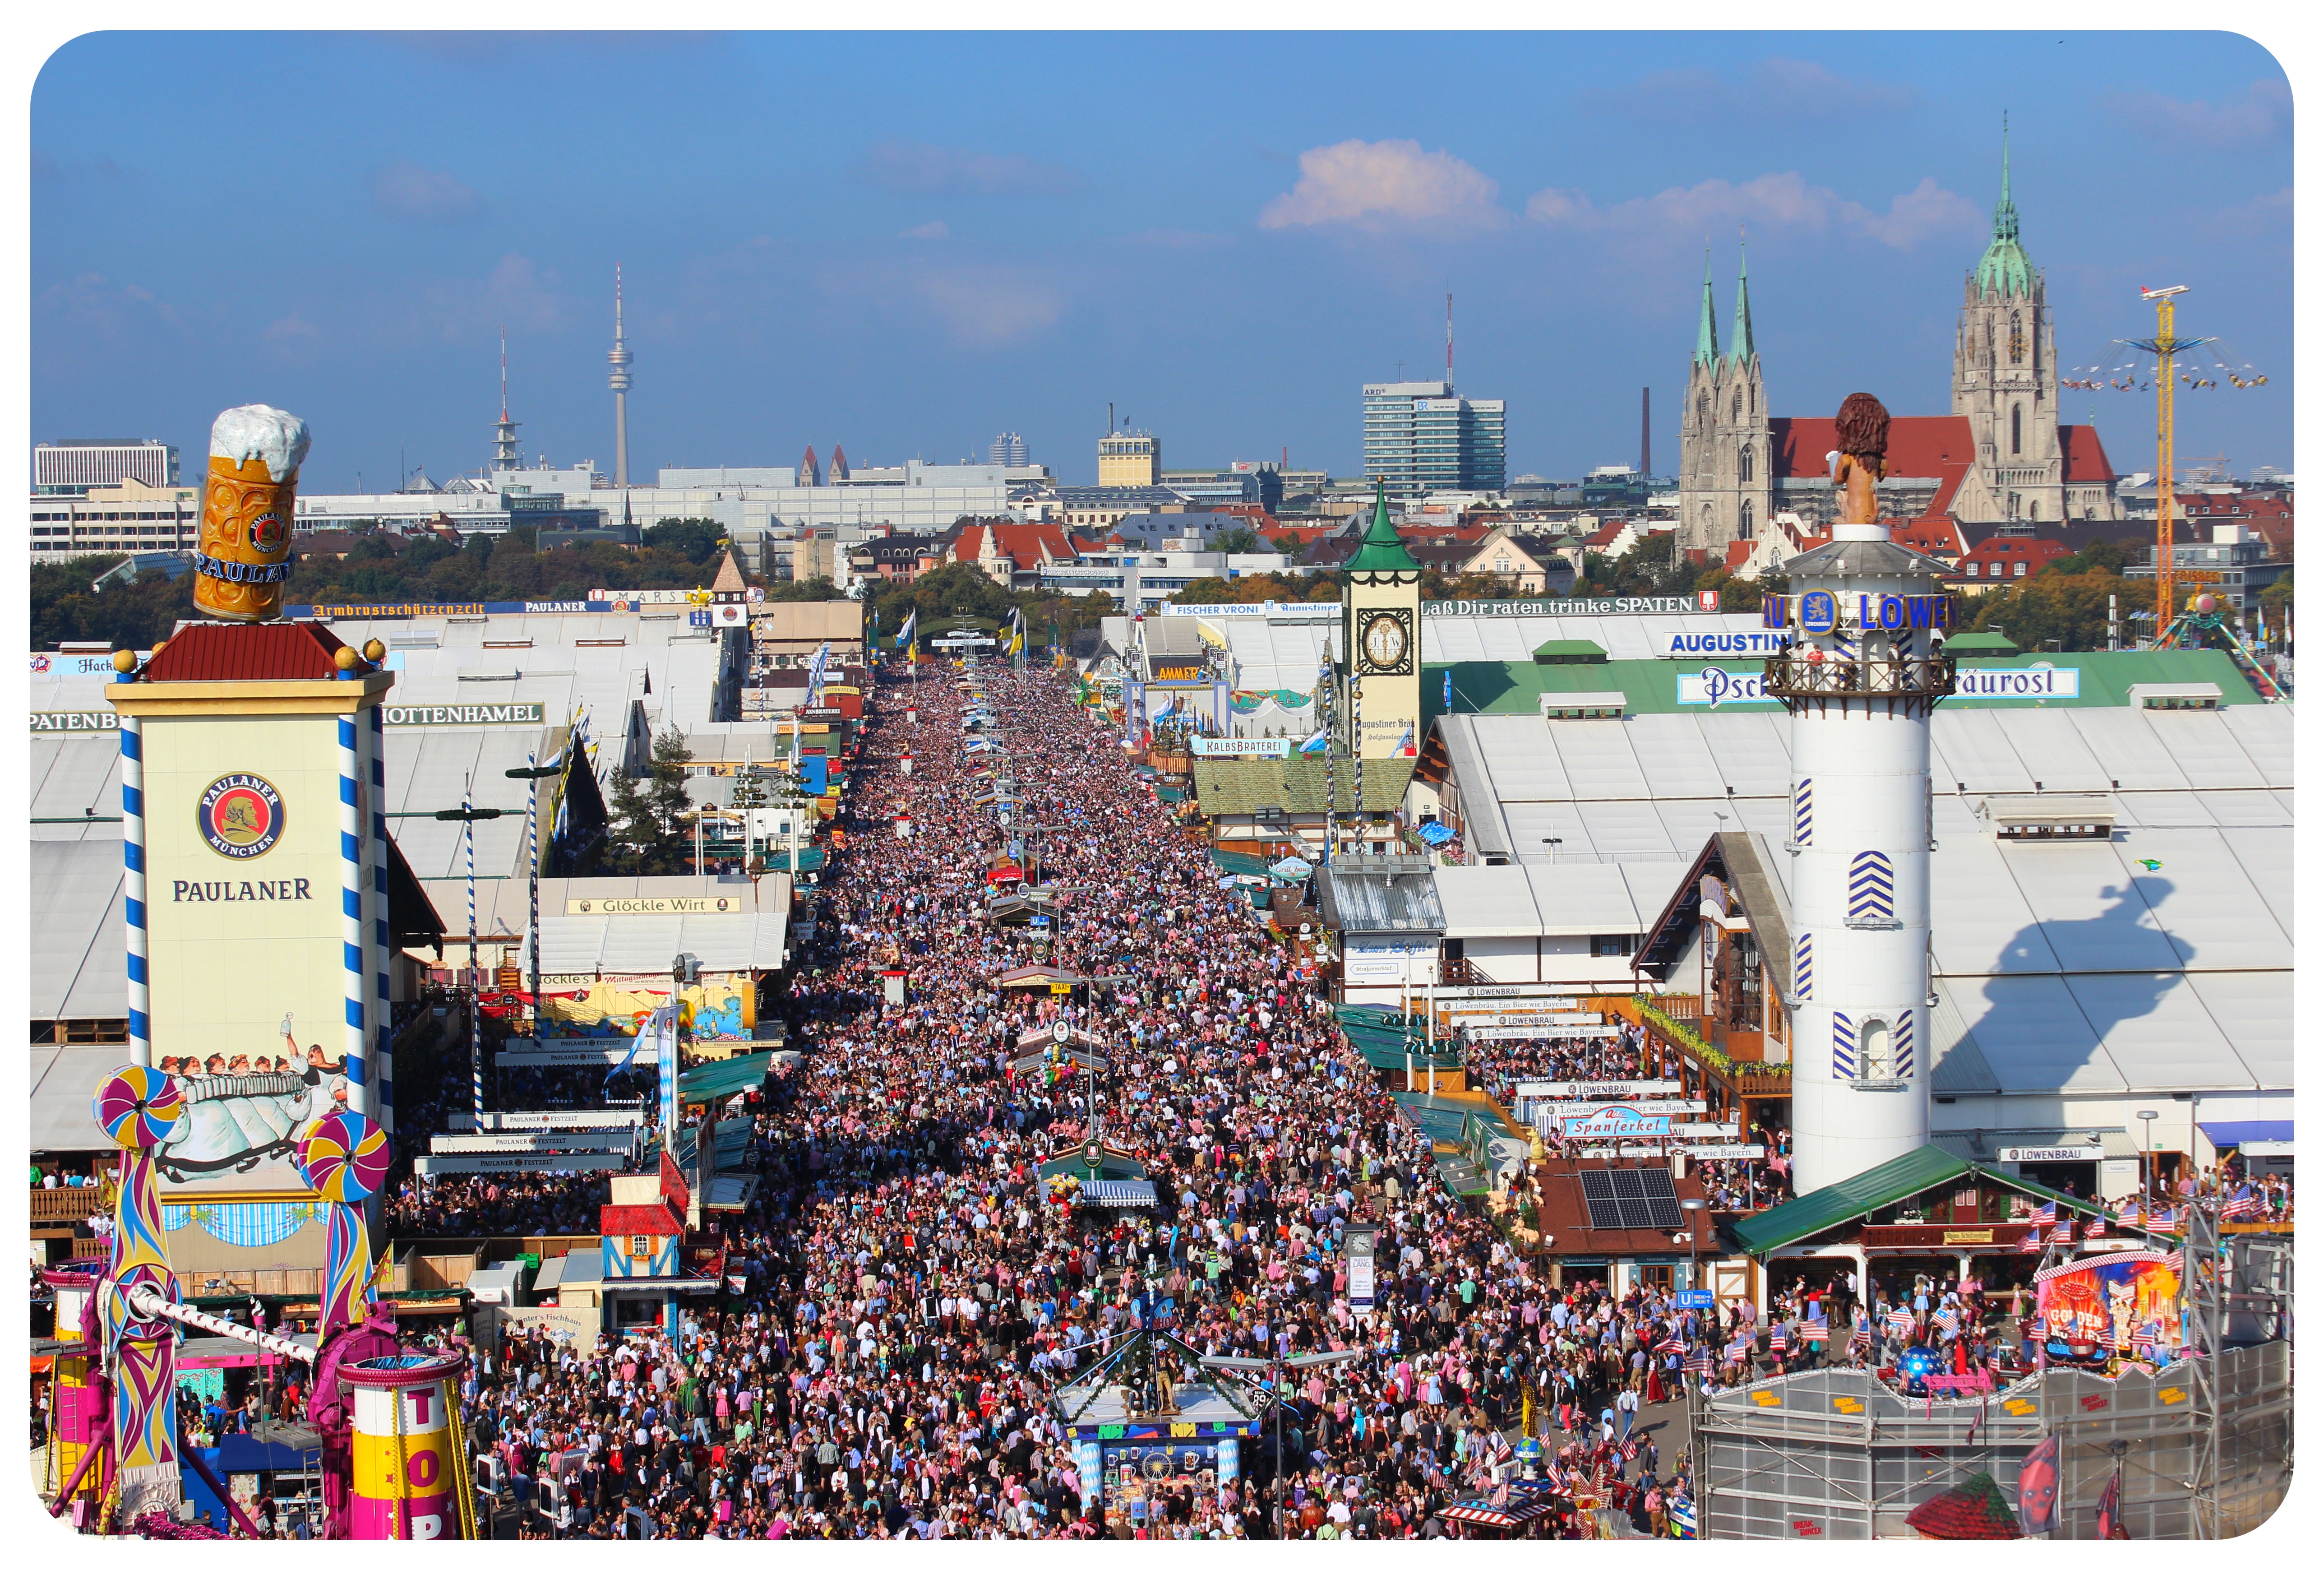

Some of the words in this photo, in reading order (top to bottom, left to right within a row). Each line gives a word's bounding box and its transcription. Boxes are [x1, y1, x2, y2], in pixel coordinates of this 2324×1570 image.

[1418, 401, 1429, 411] BR
[250, 513, 285, 530] PAULANER
[252, 540, 282, 553] MÜNCHEN
[619, 592, 688, 602] MARST
[313, 603, 485, 616] Armbrustschützenzelt
[526, 601, 587, 612] PAULANER
[1177, 607, 1220, 615] FISCHER
[1224, 606, 1258, 614] VRONI
[1421, 601, 1453, 616] Laß
[1457, 601, 1488, 615] Dir
[1548, 598, 1611, 613] trinke
[1615, 597, 1694, 612] SPATEN
[1369, 637, 1379, 648] J.
[1391, 637, 1401, 648] W.
[1159, 667, 1199, 681] AMMER
[1361, 719, 1415, 729] ugustiner-Brä
[1207, 741, 1281, 752] KALBSBRATEREI
[202, 775, 280, 807] PAULANER
[208, 834, 275, 857] MÜNCHEN
[172, 878, 314, 903] PAULANER
[603, 898, 665, 912] Glöckle
[671, 898, 706, 911] Wirt
[1476, 987, 1520, 996] LÖWENBRÄU
[1455, 1002, 1497, 1010] Löwenbräu.
[1543, 1000, 1569, 1009] Bayern.
[1508, 1015, 1555, 1024] LÖWENBRÄU
[1020, 1033, 1042, 1043] EXOTISCHE
[1579, 1028, 1607, 1037] Bayern.
[1579, 1083, 1631, 1094] LÖWENBRÄU
[1561, 1103, 1602, 1114] Löwenbrä
[1649, 1103, 1663, 1111] wie
[1666, 1102, 1697, 1113] Bayern.
[1574, 1119, 1660, 1135] Spanferkel
[1720, 1149, 1754, 1159] Bayern.
[2022, 1148, 2081, 1160] LÖWENBRÄU
[1681, 1294, 1691, 1305] U
[546, 1313, 582, 1327] Fischhaus
[1130, 1314, 1142, 1330] SHOP
[1152, 1315, 1177, 1330] SHOP
[1253, 1394, 1266, 1407] 89
[1793, 1520, 1814, 1529] BREAK
[1799, 1527, 1823, 1536] DANCER
